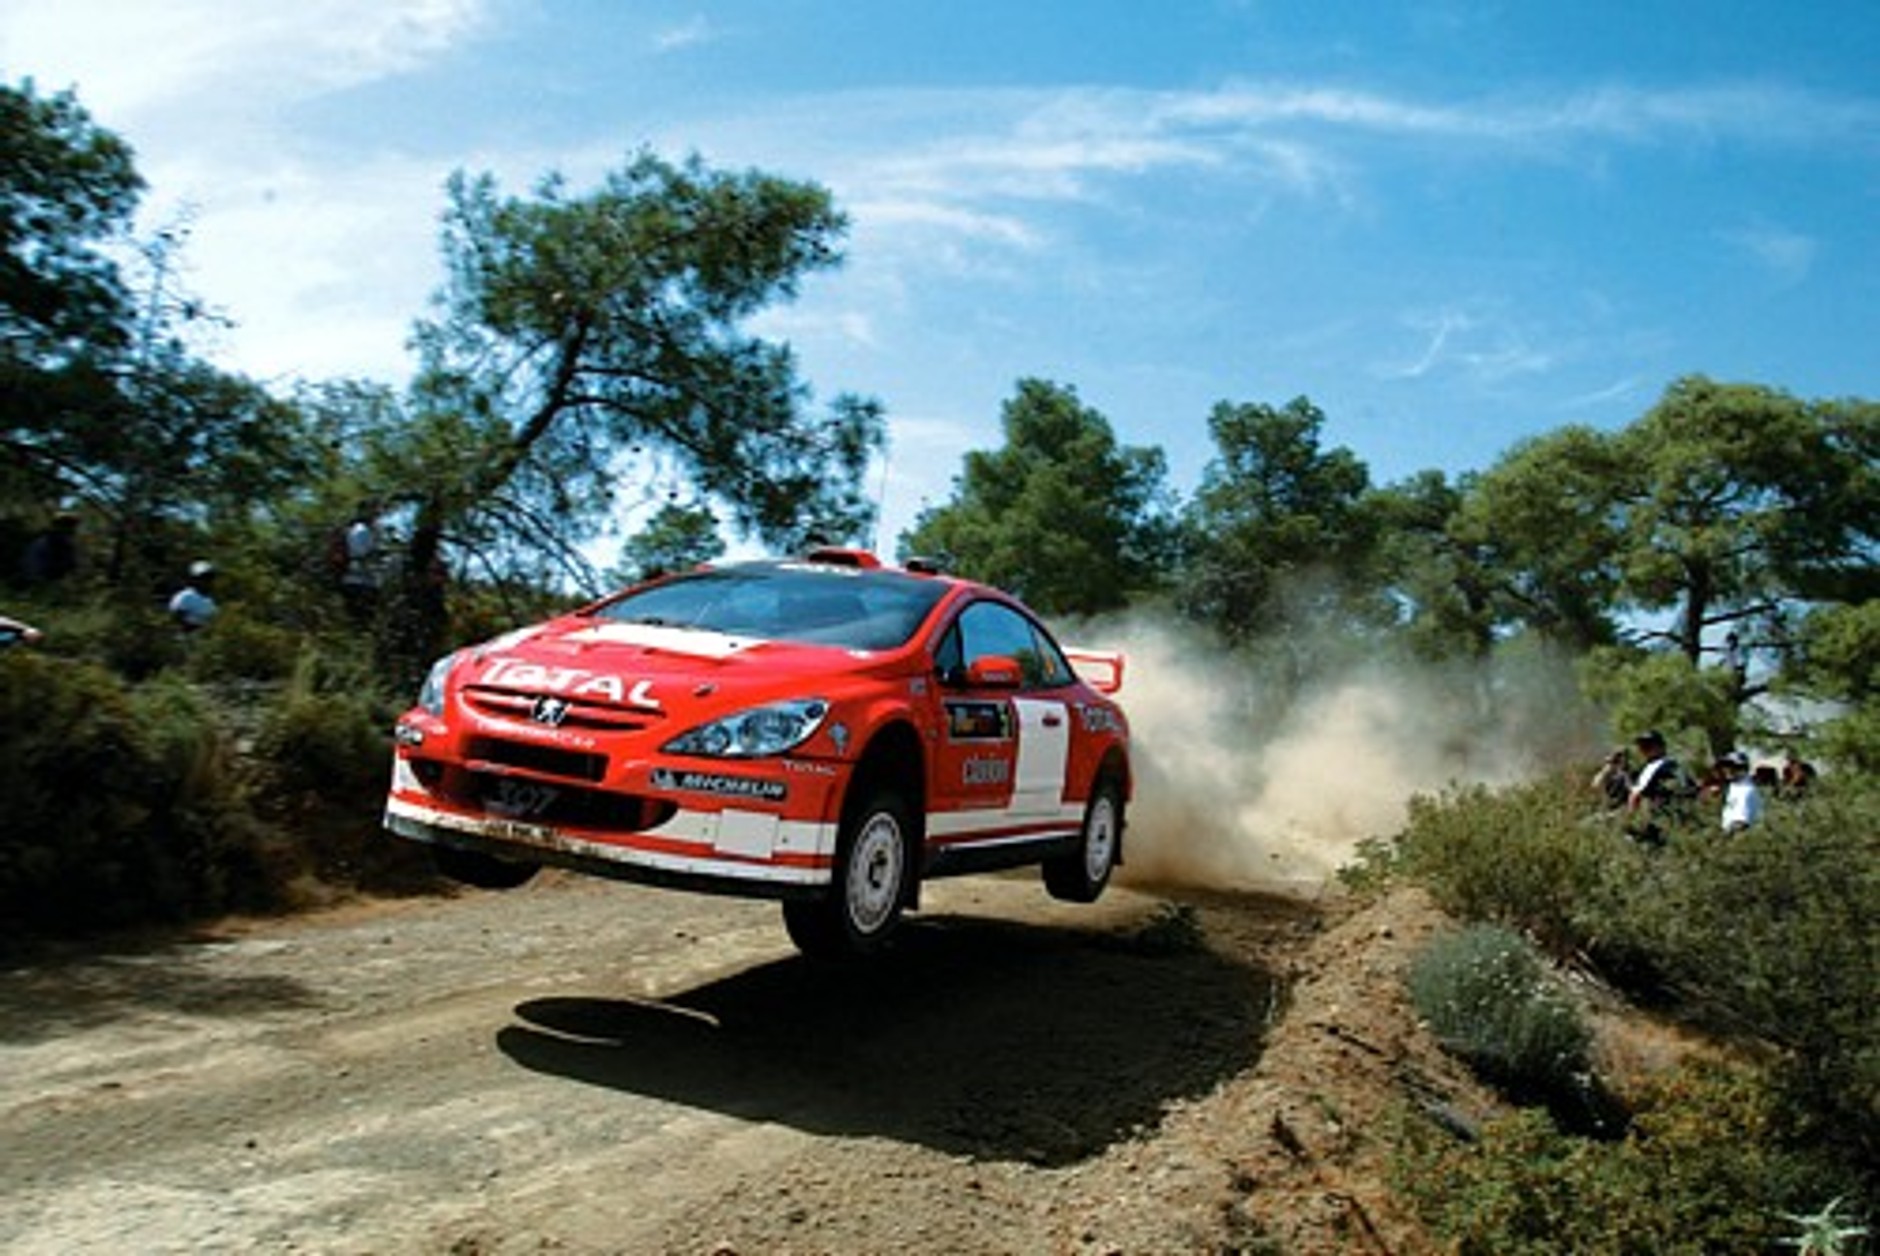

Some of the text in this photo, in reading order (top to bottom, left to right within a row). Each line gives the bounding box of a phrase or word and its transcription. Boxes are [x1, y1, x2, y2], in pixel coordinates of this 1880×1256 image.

[481, 658, 660, 708] TOTAL
[483, 781, 560, 816] 307
[681, 773, 784, 796] MICHELIN
